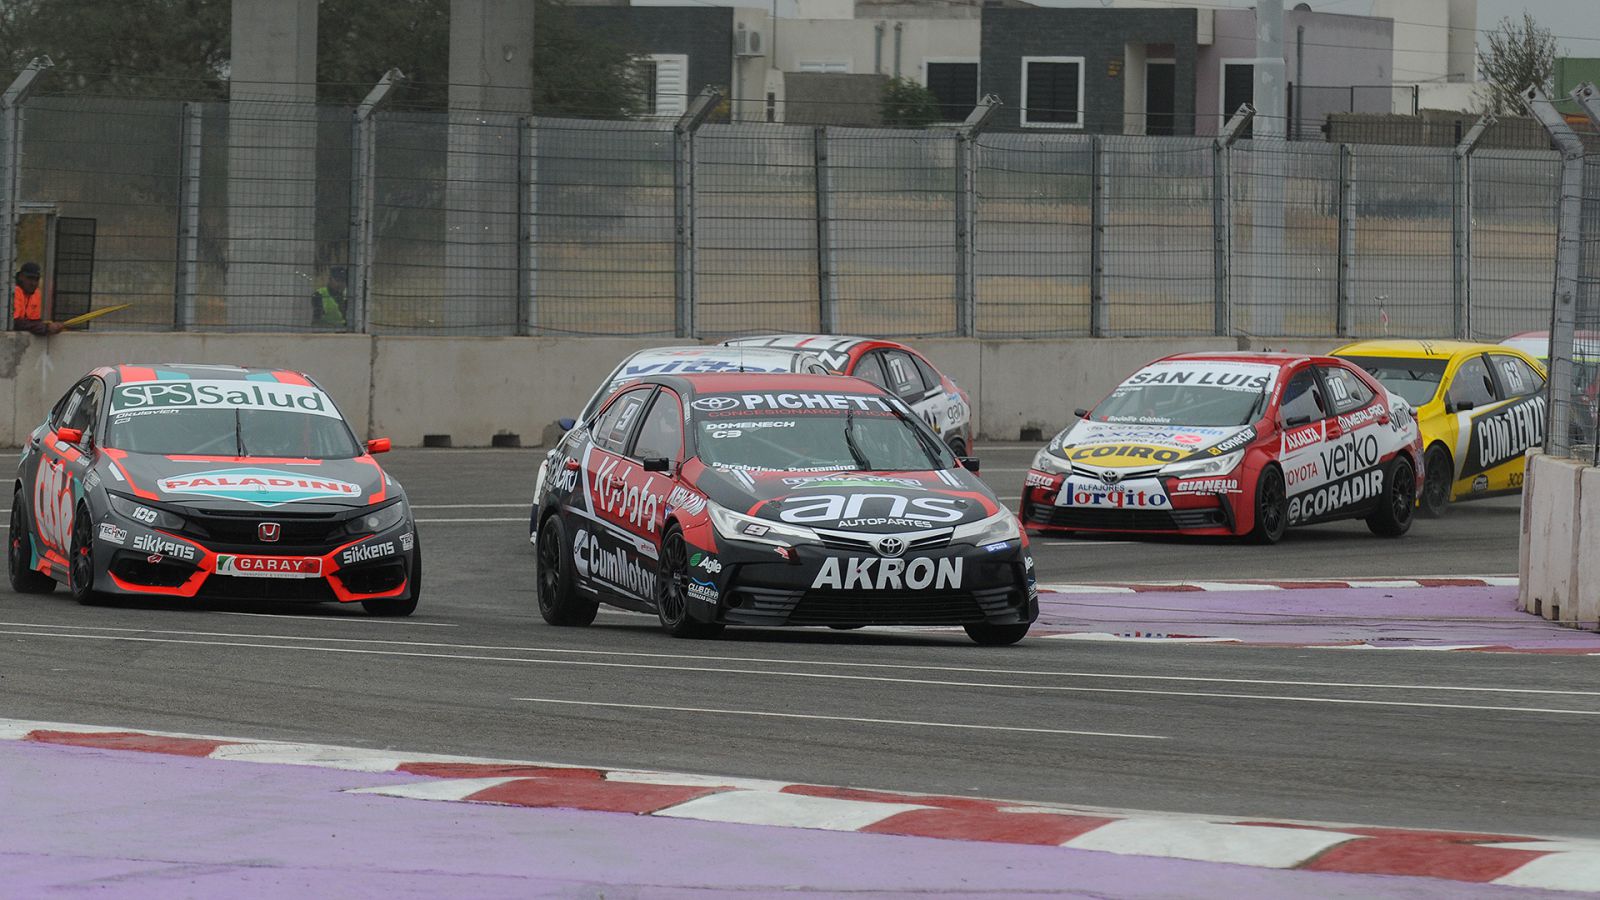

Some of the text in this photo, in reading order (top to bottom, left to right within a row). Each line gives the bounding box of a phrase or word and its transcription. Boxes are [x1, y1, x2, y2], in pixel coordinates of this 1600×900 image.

[890, 358, 906, 384] 17
[1129, 372, 1271, 388] SAN LUIS
[1503, 361, 1523, 389] 63
[121, 384, 326, 412] SPS Salud
[1328, 377, 1348, 401] 10
[706, 421, 796, 431] DOMENECH
[1285, 427, 1321, 450] AXALTA
[1071, 445, 1181, 463] COIRO
[165, 478, 353, 493] PALADINI
[1077, 484, 1125, 492] ALFAJORES
[1177, 479, 1238, 491] GIANELLO
[132, 506, 158, 523] 100
[780, 493, 966, 522] ans
[837, 517, 933, 529] AUTOPARTES
[133, 534, 195, 560] sikkens
[343, 541, 396, 565] sikkens
[240, 558, 303, 571] GARAY
[811, 556, 964, 590] AKRON
